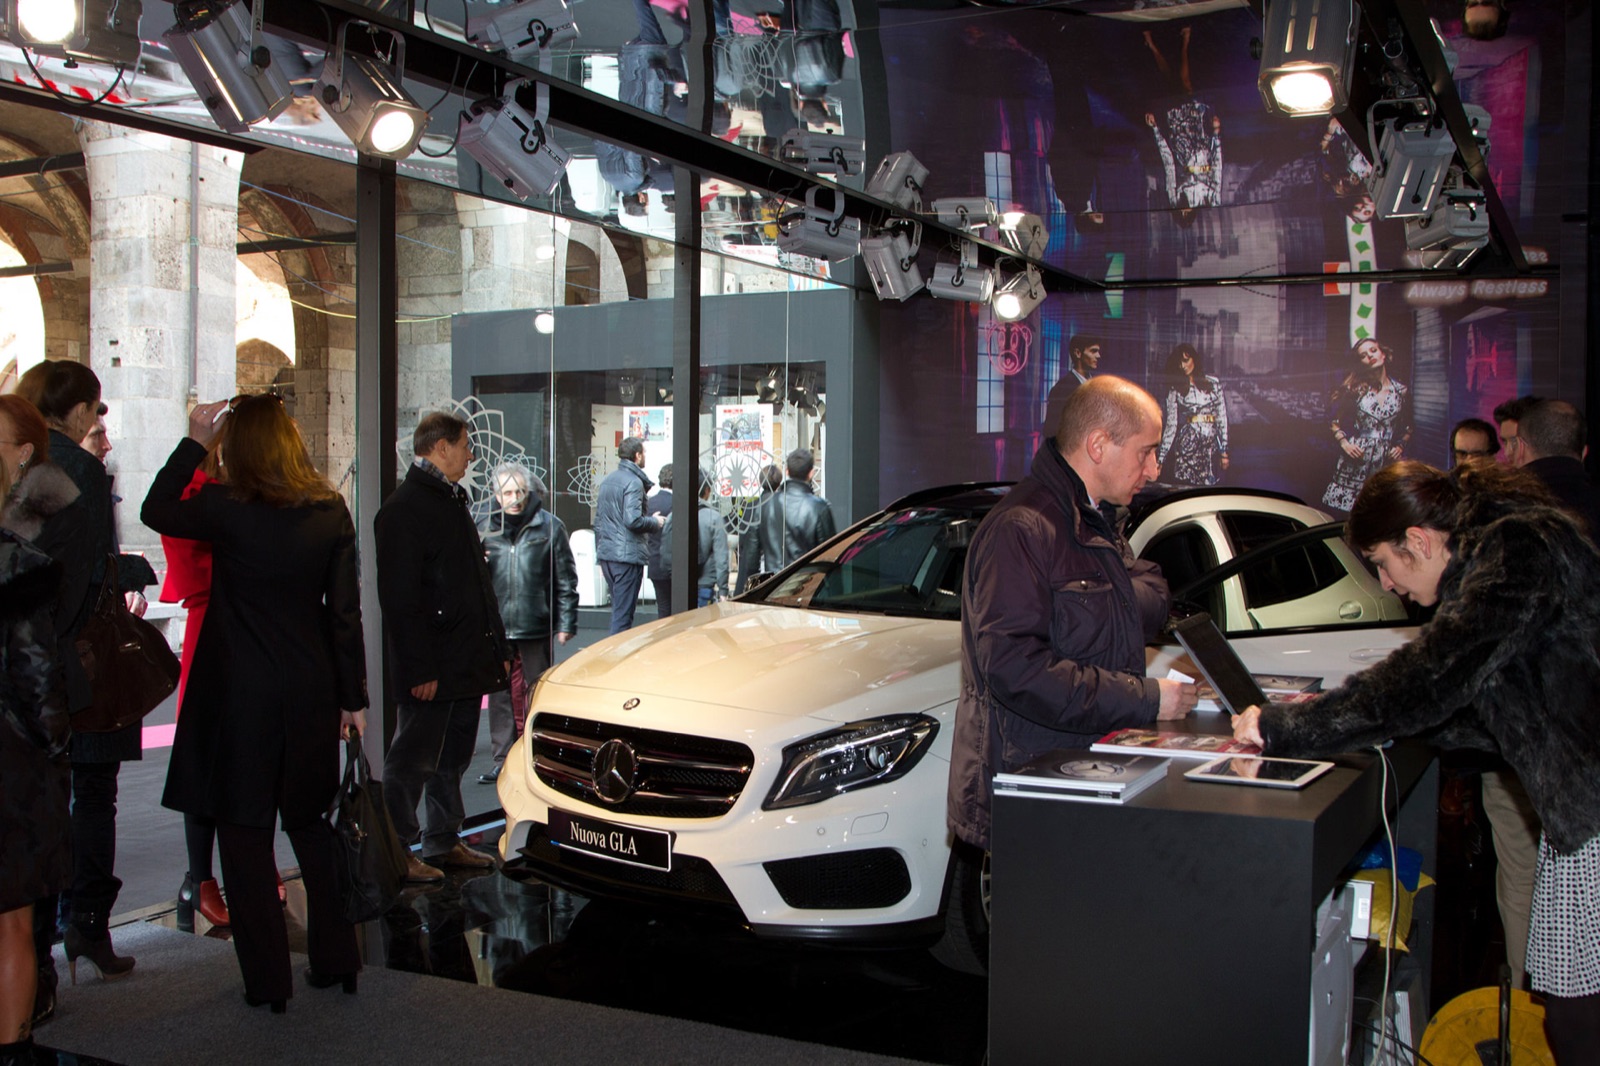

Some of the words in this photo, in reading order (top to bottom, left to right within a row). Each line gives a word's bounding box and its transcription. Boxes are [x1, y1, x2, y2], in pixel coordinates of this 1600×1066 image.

[1407, 283, 1466, 299] Always
[1474, 280, 1548, 295] Restless
[570, 821, 606, 848] Nuova
[610, 831, 638, 855] GLA
